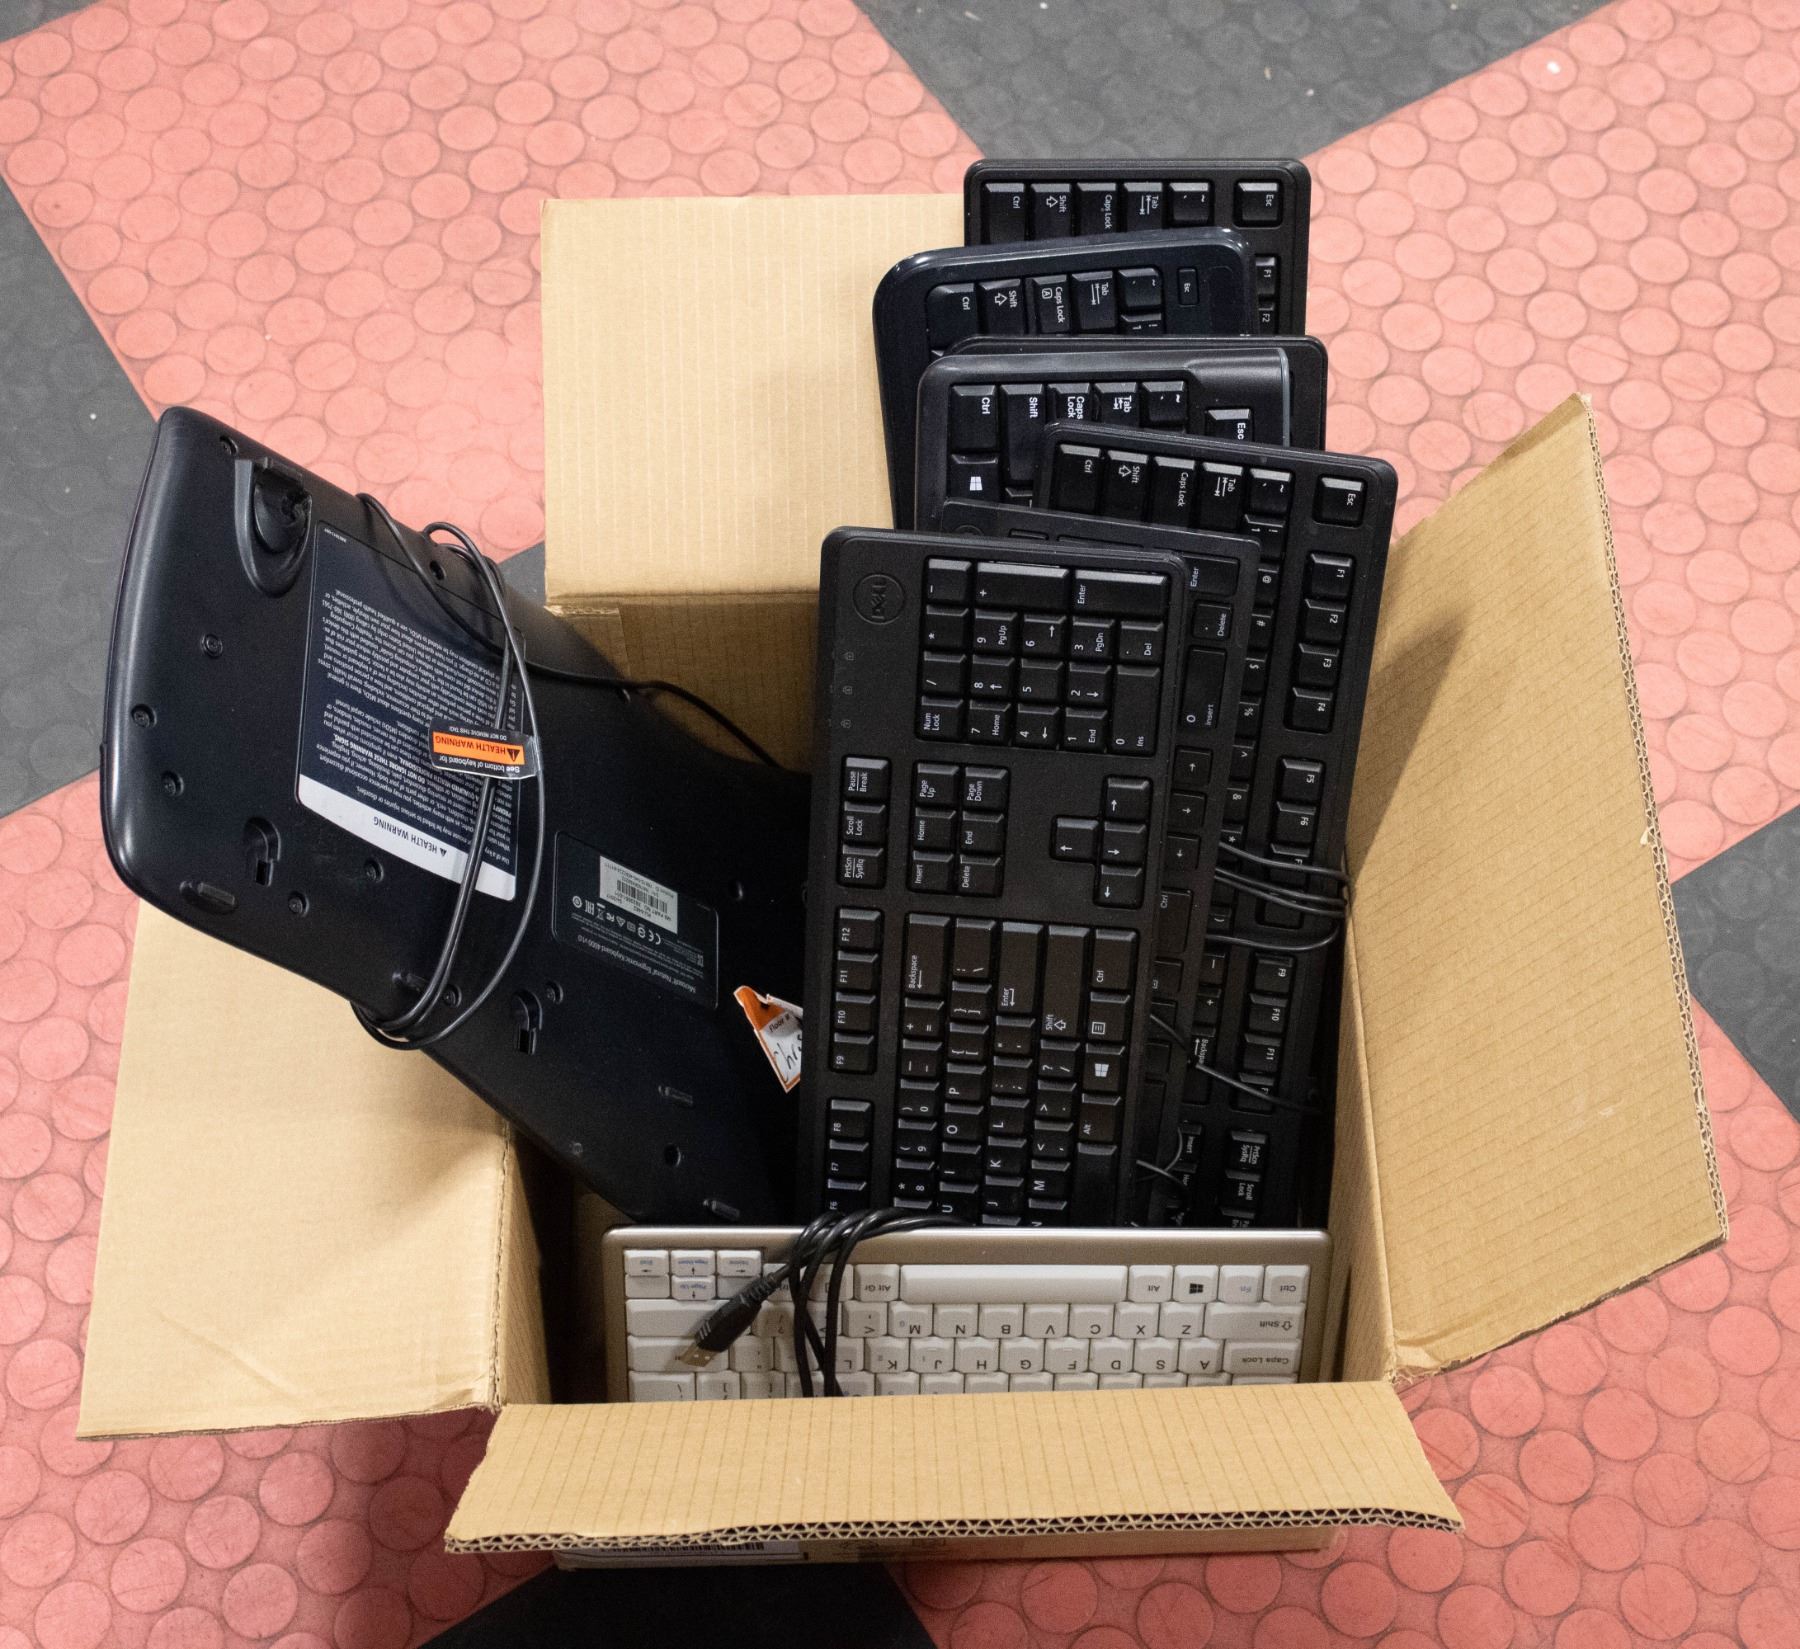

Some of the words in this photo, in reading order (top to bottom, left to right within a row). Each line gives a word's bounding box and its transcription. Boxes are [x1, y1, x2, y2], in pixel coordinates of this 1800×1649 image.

[1012, 195, 1020, 209] Ctrl
[1104, 195, 1112, 212] Caps
[1150, 196, 1158, 210] Tab
[1104, 212, 1112, 229] Lock
[1263, 269, 1271, 279] F1
[1054, 287, 1063, 304] Caps
[1100, 282, 1109, 296] Tab
[962, 297, 970, 310] Ctrl
[1008, 290, 1017, 308] Shift
[1056, 305, 1065, 323] Lock
[1262, 312, 1270, 323] F2
[981, 397, 990, 414] Ctrl
[1029, 397, 1038, 418] Shift
[1067, 396, 1076, 418] Lock
[1076, 396, 1085, 419] Caps
[1123, 396, 1131, 413] Tab
[1237, 422, 1245, 440] Esc
[1084, 459, 1092, 473] Ctrl
[1131, 466, 1139, 484] Shift
[1179, 472, 1188, 489] Caps
[1227, 479, 1236, 492] Tab
[1178, 490, 1186, 507] Lock
[1346, 493, 1354, 506] Esc
[1189, 567, 1199, 588] Enter
[1338, 569, 1345, 578] F1
[1077, 584, 1086, 605] Enter
[1217, 613, 1226, 637] Delete
[1330, 614, 1338, 624] F2
[998, 625, 1007, 645] PgUp
[1095, 632, 1104, 652] PgDn
[1144, 642, 1152, 656] Del
[1323, 658, 1331, 668] F3
[1316, 702, 1326, 712] F4
[923, 713, 931, 730] Num
[932, 713, 940, 731] Lock
[1205, 704, 1214, 726] Insert
[992, 714, 1000, 736] Home
[471, 730, 489, 738] REMOVE
[1088, 729, 1097, 743] End
[435, 736, 474, 749] WARNING
[476, 743, 506, 754] HEALTH
[1137, 736, 1145, 747] Ins
[448, 756, 476, 767] keyboard
[485, 763, 504, 772] bottom
[848, 771, 857, 792] Pause
[860, 772, 868, 792] Break
[1306, 775, 1315, 783] F5
[920, 779, 929, 798] Page
[927, 787, 935, 798] Up
[967, 781, 975, 801] Page
[975, 781, 983, 801] Down
[373, 815, 408, 840] WARNING
[846, 815, 855, 836] Scroll
[855, 819, 863, 836] Lock
[1300, 817, 1308, 826] F6
[917, 820, 925, 841] Home
[411, 833, 436, 853] HEALTH
[965, 831, 974, 845] End
[855, 858, 864, 879] SysRq
[914, 864, 922, 884] Insert
[962, 865, 970, 888] Delete
[842, 927, 851, 942] F12
[840, 970, 848, 983] F11
[909, 955, 918, 989] Backspace
[1096, 970, 1105, 983] Ctrl
[1278, 968, 1286, 977] F9
[1001, 988, 1009, 1007] Enter
[837, 1010, 846, 1024] F10
[1046, 1014, 1054, 1030] Shift
[1271, 1008, 1280, 1022] F10
[836, 1056, 844, 1065] F9
[1266, 1047, 1275, 1061] F11
[1083, 1124, 1091, 1135] Alt
[831, 1162, 839, 1171] F7
[990, 1160, 1001, 1168] K
[1034, 1180, 1045, 1190] M
[909, 1324, 921, 1335] M
[956, 1324, 966, 1335] N
[1000, 1325, 1011, 1335] B
[1044, 1325, 1056, 1335] V
[1090, 1324, 1101, 1335] C
[1136, 1325, 1145, 1335] X
[1182, 1325, 1191, 1335] Z
[843, 1360, 852, 1369] L
[887, 1360, 898, 1369] K
[934, 1360, 942, 1370] J
[976, 1360, 987, 1369] H
[1020, 1360, 1031, 1370] G
[1067, 1360, 1077, 1370] F
[1111, 1360, 1122, 1370] D
[1156, 1360, 1166, 1370] S
[1199, 1360, 1211, 1370] A
[1266, 1357, 1290, 1365] Caps
